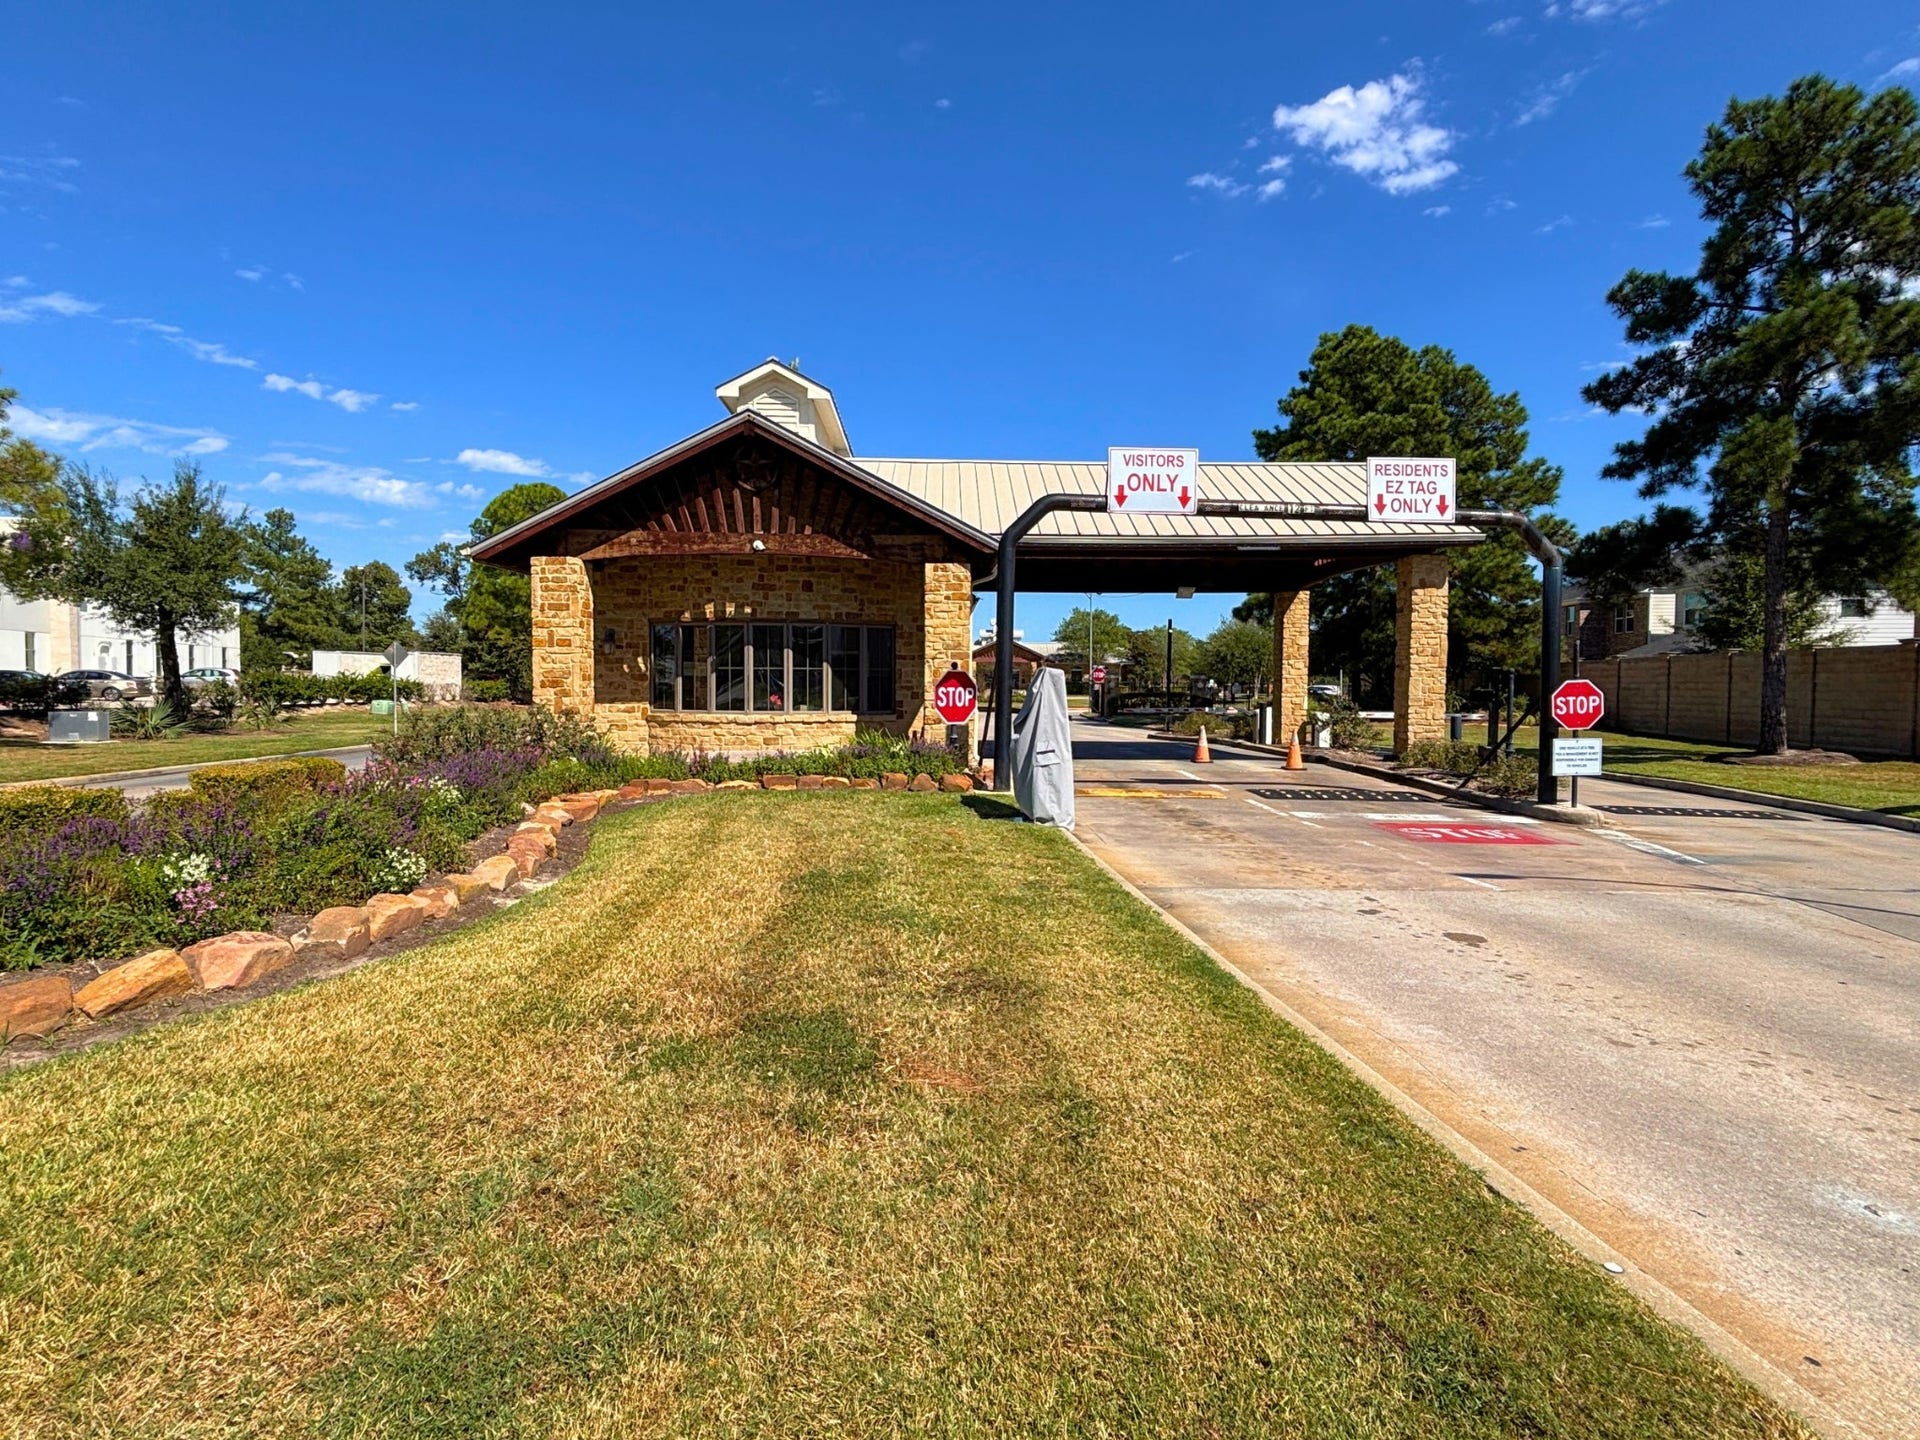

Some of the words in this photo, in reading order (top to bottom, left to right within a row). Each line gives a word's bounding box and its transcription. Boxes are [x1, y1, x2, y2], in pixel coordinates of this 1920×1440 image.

[1123, 454, 1184, 467] VISITORS
[1375, 464, 1448, 477] RESIDENTS
[1127, 473, 1179, 492] ONLY
[1386, 480, 1404, 494] EZ
[1408, 481, 1437, 494] TAG
[1390, 498, 1432, 513] ONLY
[937, 686, 974, 707] STOP
[1556, 696, 1600, 715] STOP
